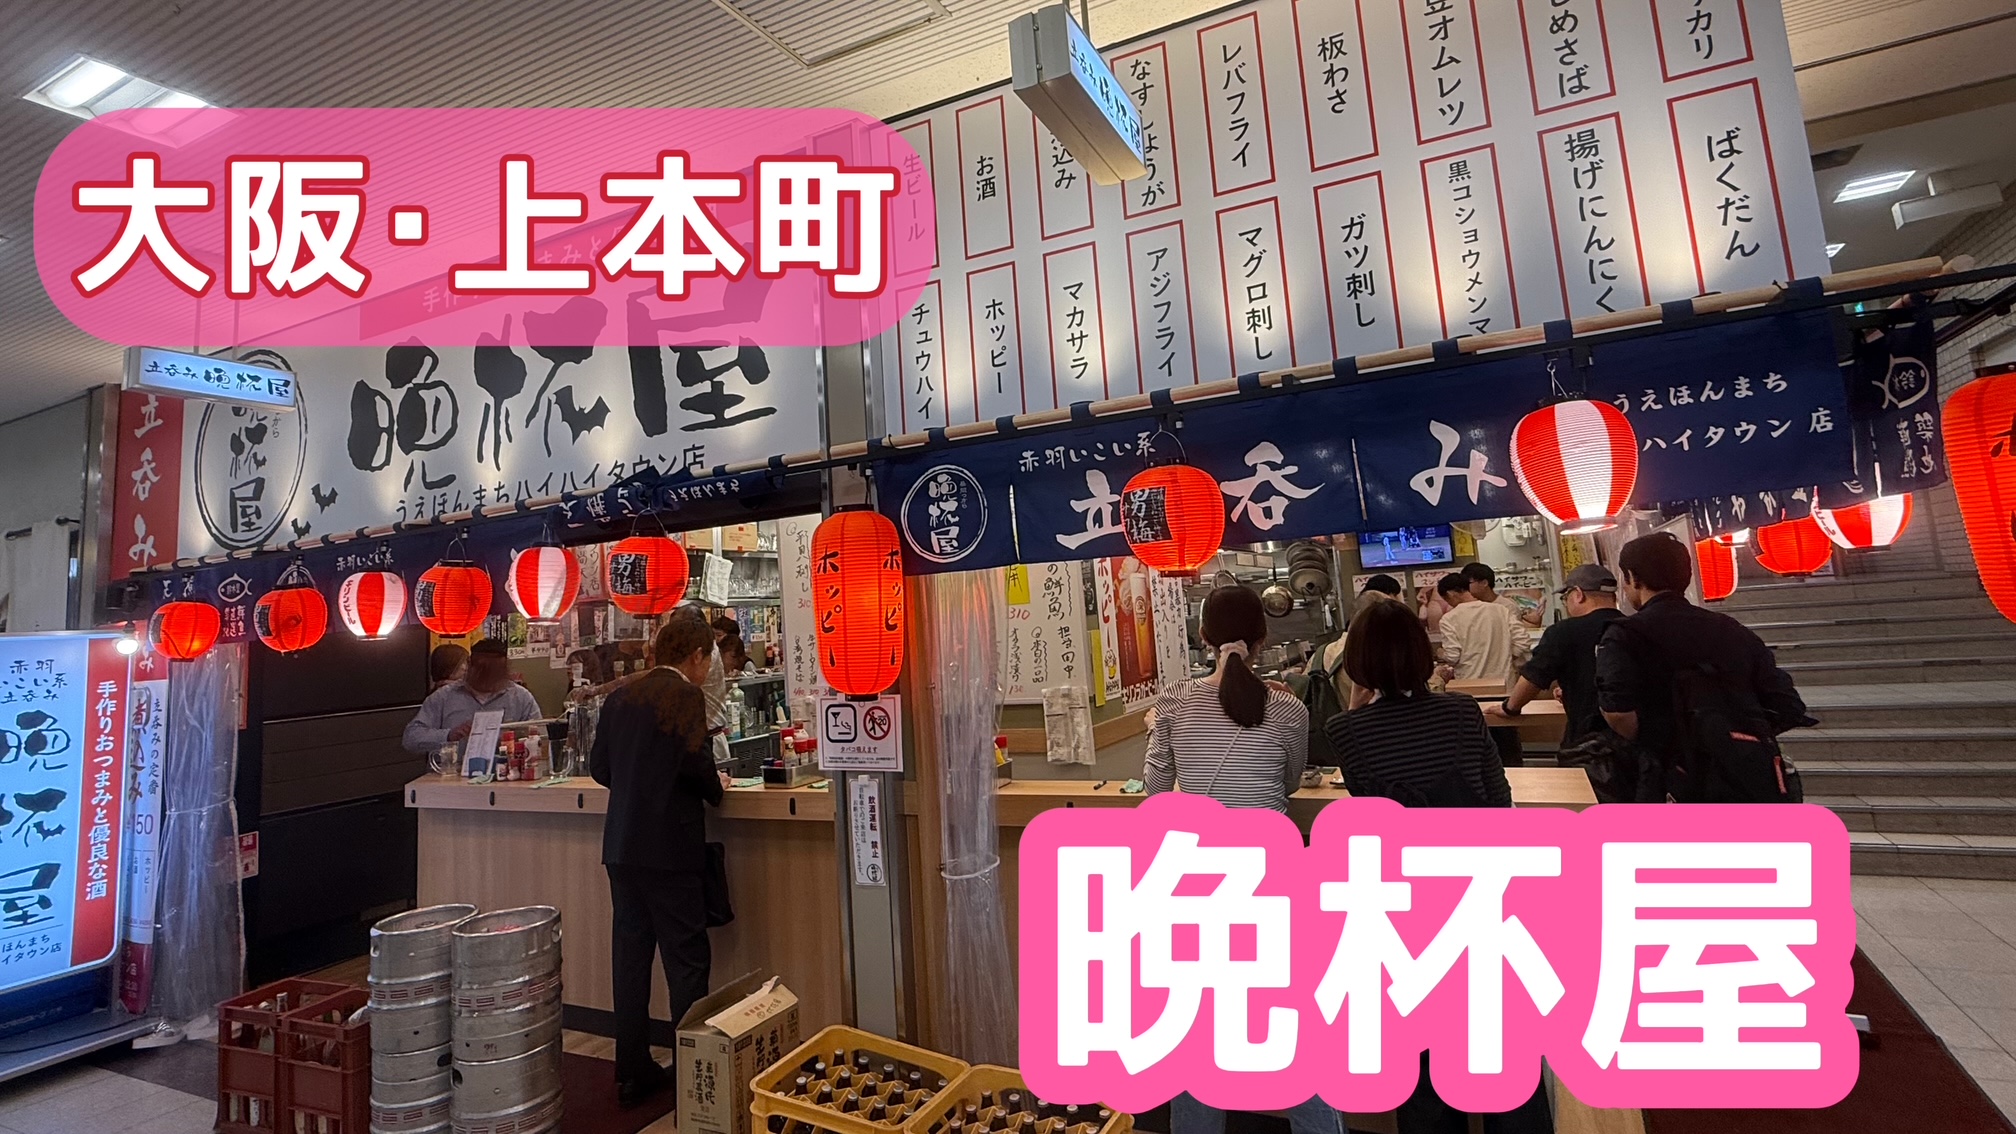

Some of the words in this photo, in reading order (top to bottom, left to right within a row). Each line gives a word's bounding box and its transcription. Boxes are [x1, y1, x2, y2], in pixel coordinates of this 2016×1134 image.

[1317, 32, 1350, 114] 板わさ
[1686, 0, 1714, 59] カリ
[1222, 43, 1251, 168] レバフライ
[903, 153, 925, 243] 生ビール
[976, 154, 997, 202] お酒
[1049, 135, 1077, 190] 込み
[1706, 126, 1761, 261] ばくだん
[1448, 159, 1492, 335] 黒コショウメンマ
[1564, 128, 1618, 313] 揚げにんにく
[1146, 247, 1176, 378] アジフライ
[1238, 226, 1273, 361] マグロ刺し
[1340, 211, 1377, 328] ガツ刺し
[911, 302, 935, 420] チュウハイ
[984, 298, 1008, 394] ホッピー
[1062, 281, 1089, 380] マカサラ
[145, 360, 199, 381] 立呑み
[203, 367, 292, 398] 晩杯屋
[1612, 371, 1788, 414] うえほんまち
[127, 394, 164, 566] 立呑み
[1017, 430, 1157, 474] 赤羽いこい系
[816, 543, 842, 668] ホッピー
[882, 543, 902, 666] ホッピー
[1097, 558, 1113, 648] ホッピー
[0, 688, 59, 704] 立呑み
[9, 659, 55, 674] 赤羽
[84, 680, 118, 901] 手作りおつまみと優良な酒
[868, 795, 878, 832] 飲酒運転
[871, 840, 879, 859] 禁止
